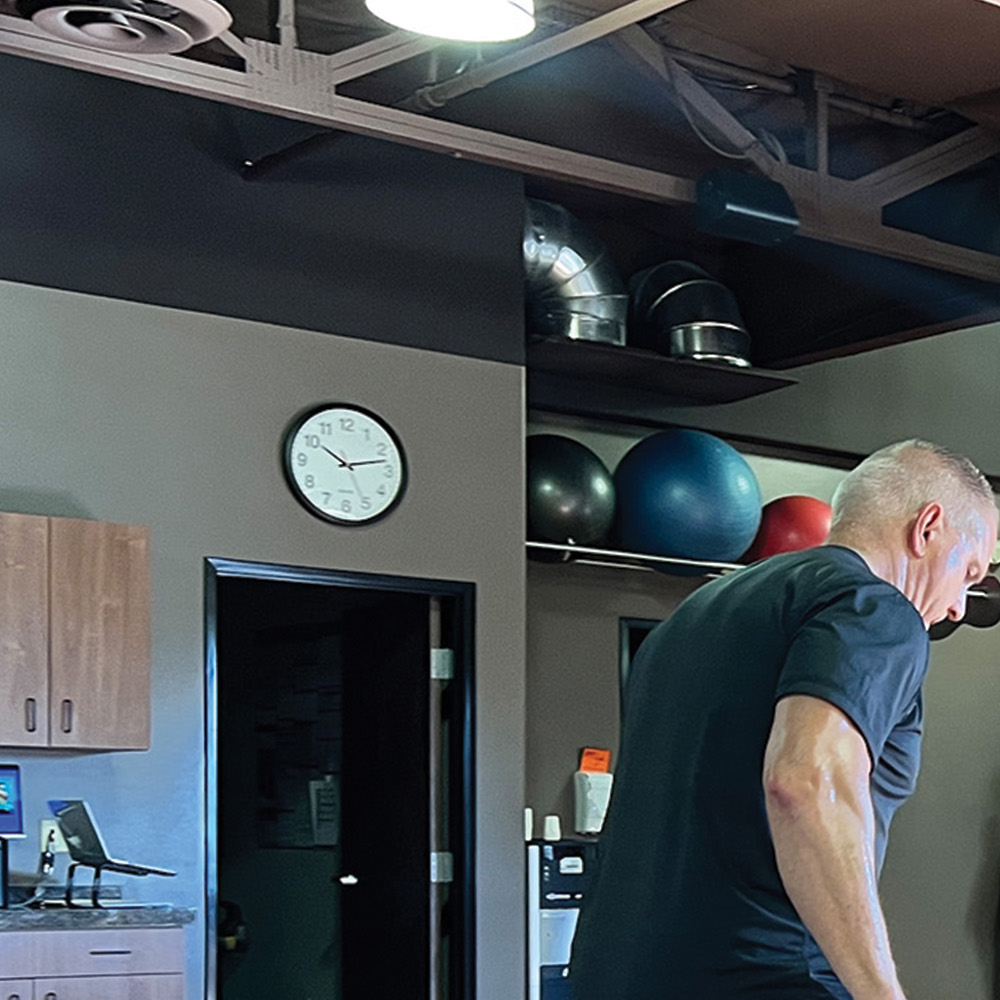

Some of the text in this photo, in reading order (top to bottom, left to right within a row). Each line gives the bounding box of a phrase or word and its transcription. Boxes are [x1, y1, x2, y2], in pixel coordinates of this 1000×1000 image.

[319, 422, 332, 435] 11
[339, 418, 354, 432] 12
[304, 435, 320, 449] 10
[363, 429, 370, 441] 1
[377, 442, 388, 456] 2
[297, 452, 308, 467] 9
[383, 464, 394, 478] 3
[304, 474, 315, 488] 8
[321, 491, 332, 505] 7
[361, 497, 371, 510] 5
[340, 499, 352, 513] 6
